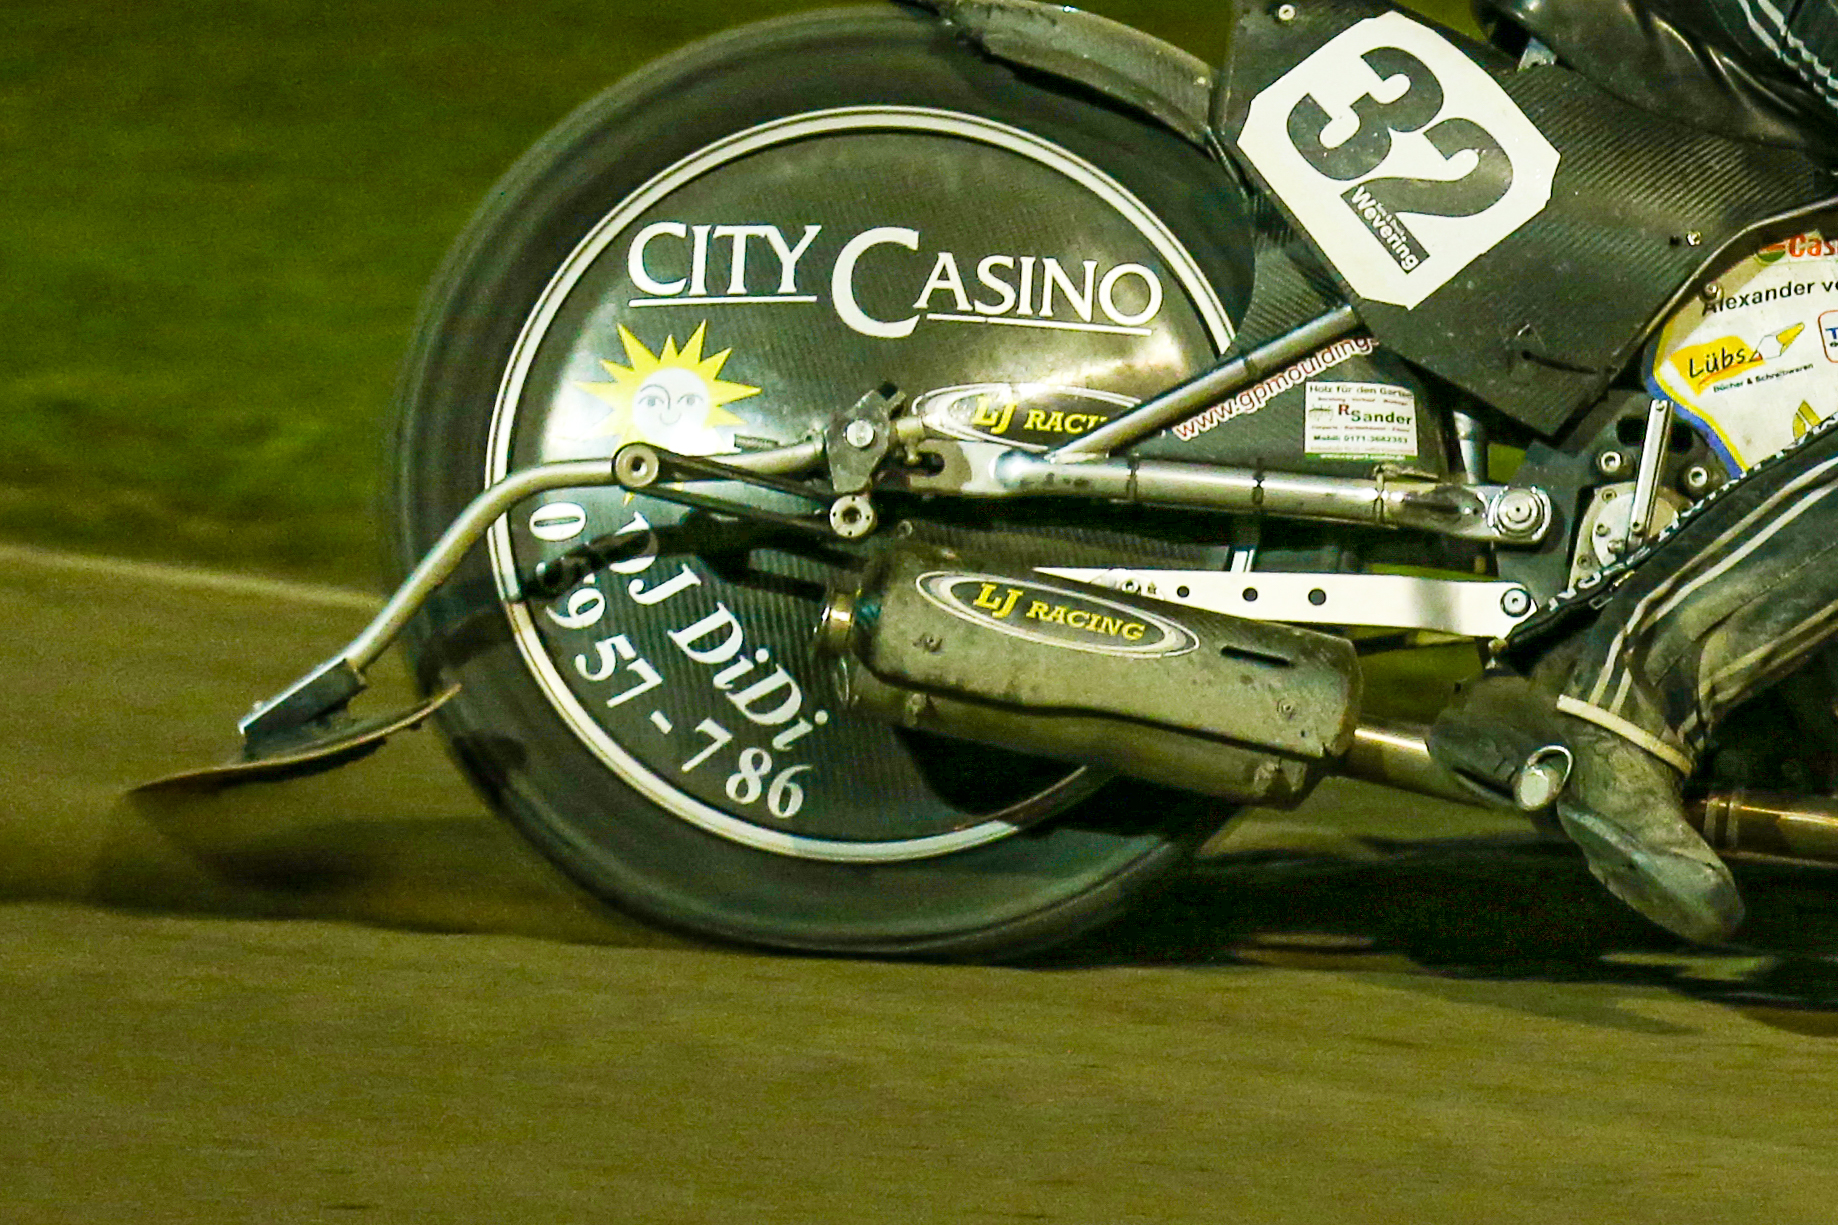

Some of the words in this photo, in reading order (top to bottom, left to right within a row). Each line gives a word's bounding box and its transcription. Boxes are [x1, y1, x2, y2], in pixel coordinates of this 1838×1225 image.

[1287, 46, 1514, 274] 32
[1351, 185, 1420, 271] Wevering
[627, 221, 822, 297] CITY
[1701, 281, 1815, 317] Alexander
[1688, 345, 1746, 378] Lübs
[1356, 385, 1377, 394] den
[972, 395, 1018, 435] LJ
[1351, 409, 1413, 425] Sander
[973, 582, 1024, 619] LJ
[1026, 599, 1146, 641] RACING
[667, 601, 830, 752] DiDi
